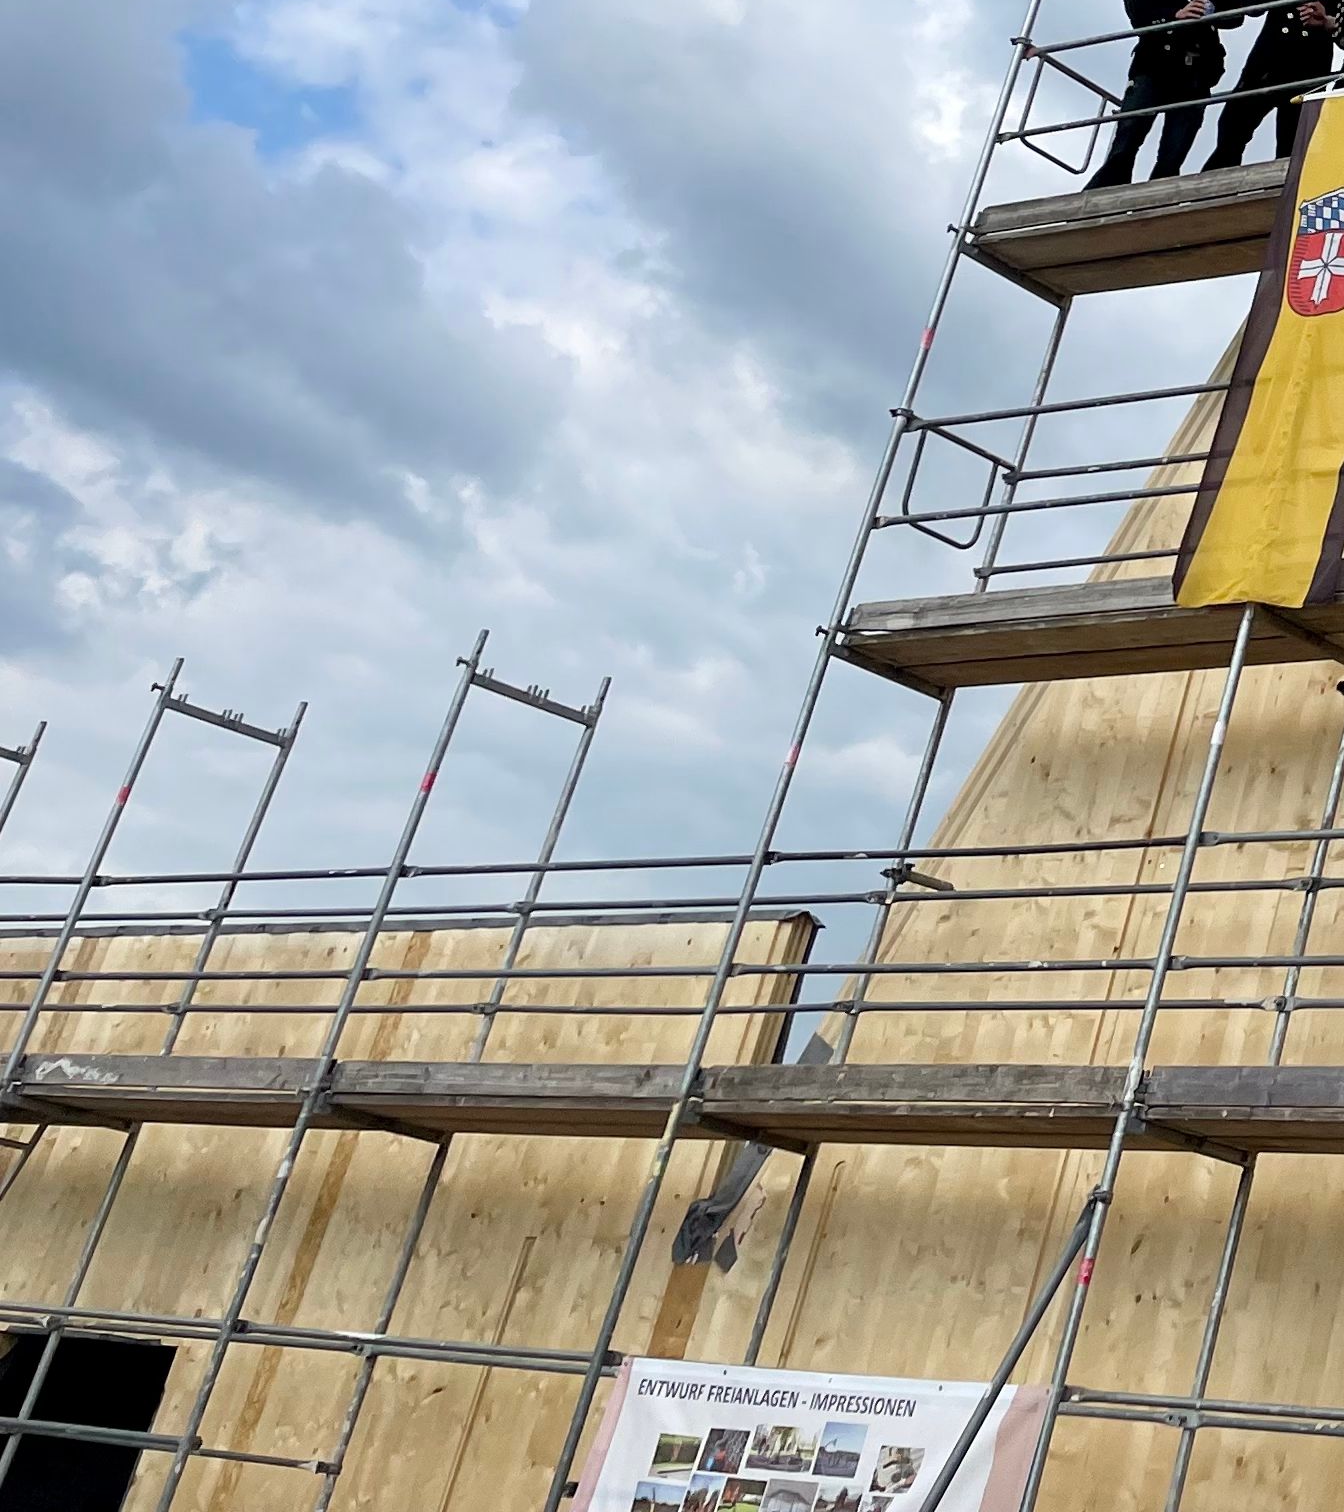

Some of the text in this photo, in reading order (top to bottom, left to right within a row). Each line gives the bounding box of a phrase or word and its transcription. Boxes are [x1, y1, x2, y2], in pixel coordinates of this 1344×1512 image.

[637, 1378, 706, 1401] ENTWURF
[706, 1384, 800, 1409] FREIANLAGEN
[809, 1392, 917, 1418] IMPRESSIONEN
